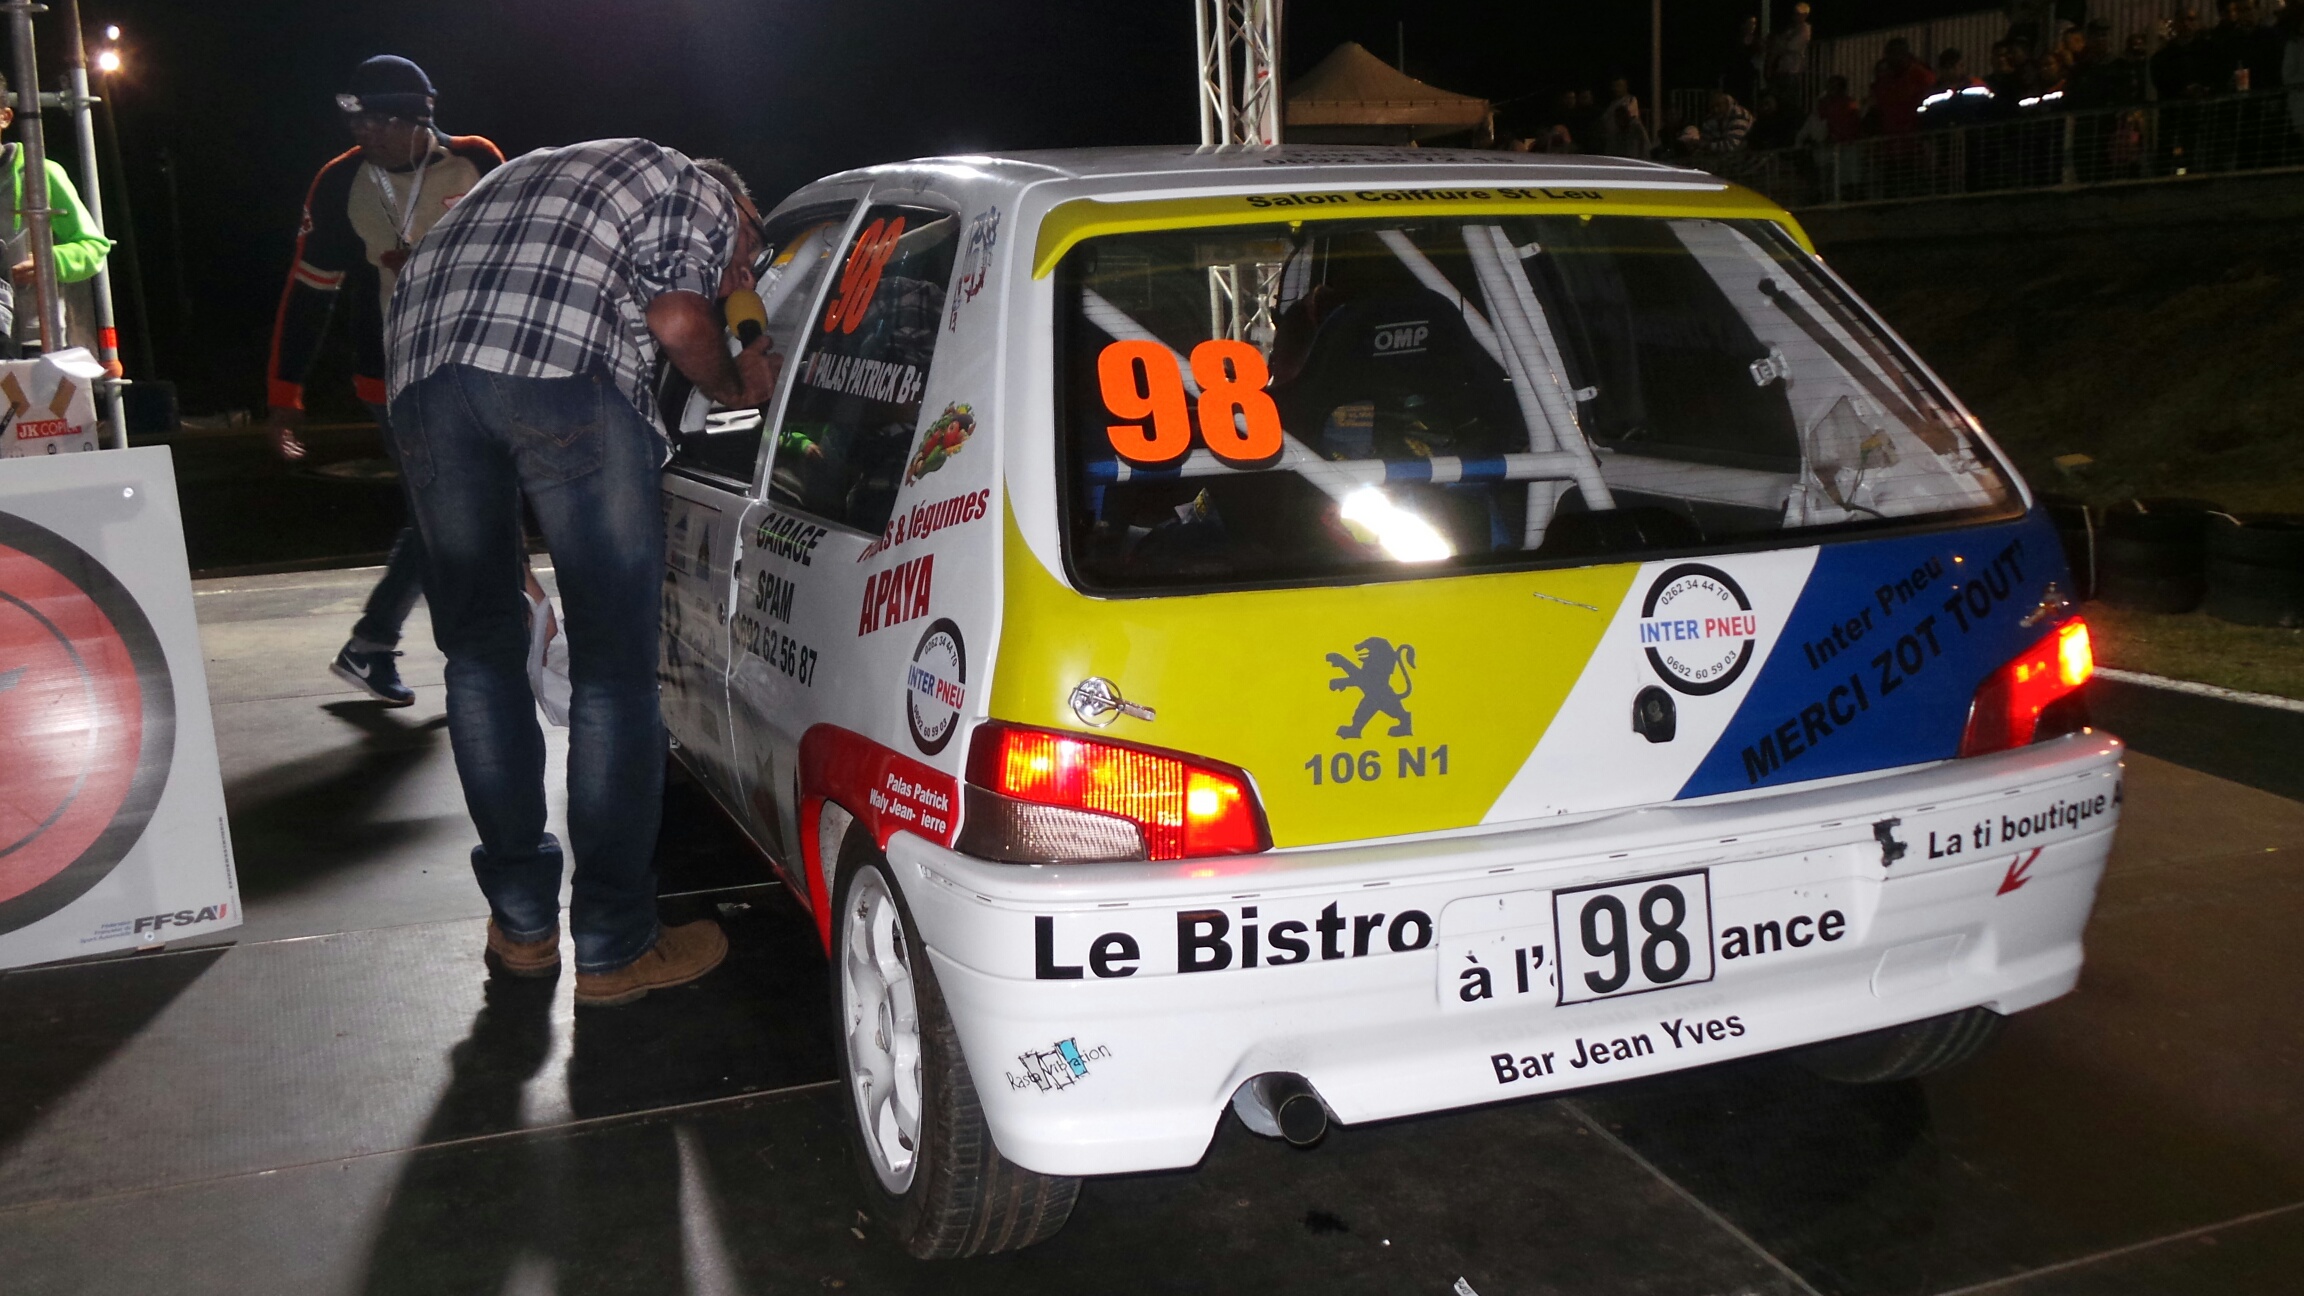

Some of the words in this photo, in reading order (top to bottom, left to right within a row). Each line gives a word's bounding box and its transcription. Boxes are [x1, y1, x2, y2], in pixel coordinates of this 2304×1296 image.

[1246, 190, 1348, 208] Salon
[1355, 186, 1492, 204] Coiffure
[1496, 187, 1528, 201] St
[1537, 187, 1604, 201] Leu
[823, 216, 906, 335] 98
[1374, 326, 1429, 350] OMP
[812, 352, 851, 393] PALAS
[845, 357, 904, 403] PATRICK
[896, 364, 922, 405] B+
[1097, 339, 1284, 462] 98
[19, 423, 39, 439] JK
[756, 512, 828, 567] GARAGE
[894, 514, 906, 546] &
[906, 487, 990, 541] légumes
[756, 569, 796, 624] SPAM
[858, 553, 934, 638] APAYA
[1661, 584, 1684, 606] 0262
[1685, 579, 1699, 590] 34
[1701, 580, 1714, 592] 44
[1716, 586, 1729, 602] 70
[1803, 606, 1875, 671] Inter
[1875, 555, 1944, 618] Pneu
[1640, 619, 1700, 643] INTER
[1705, 615, 1756, 639] PNEU
[762, 626, 777, 667] 62
[780, 635, 797, 678] 56
[799, 645, 818, 688] 87
[1666, 655, 1692, 677] 0692
[1695, 668, 1709, 680] 60
[1711, 662, 1723, 675] 59
[1724, 650, 1737, 665] 03
[907, 664, 936, 697] INTER
[935, 678, 965, 710] PNEU
[1741, 673, 1870, 785] MERCI
[1870, 615, 1942, 697] ZOT
[1305, 749, 1382, 785] 106
[1398, 744, 1448, 778] N1
[869, 787, 889, 815] Waly
[886, 772, 912, 797] Palas
[913, 783, 949, 812] Patrick
[1927, 830, 1963, 860] La
[1973, 818, 1992, 850] ti
[2000, 793, 2106, 844] boutique
[133, 905, 218, 934] FFSA
[1034, 914, 1141, 980] Le
[1176, 899, 1434, 974] Bistro
[1578, 883, 1692, 995] 98
[1458, 950, 1494, 1003] à
[1490, 1049, 1556, 1085] Bar
[1569, 1032, 1655, 1070] Jean
[1660, 1013, 1747, 1049] Yves
[1005, 1070, 1043, 1092] Rasta
